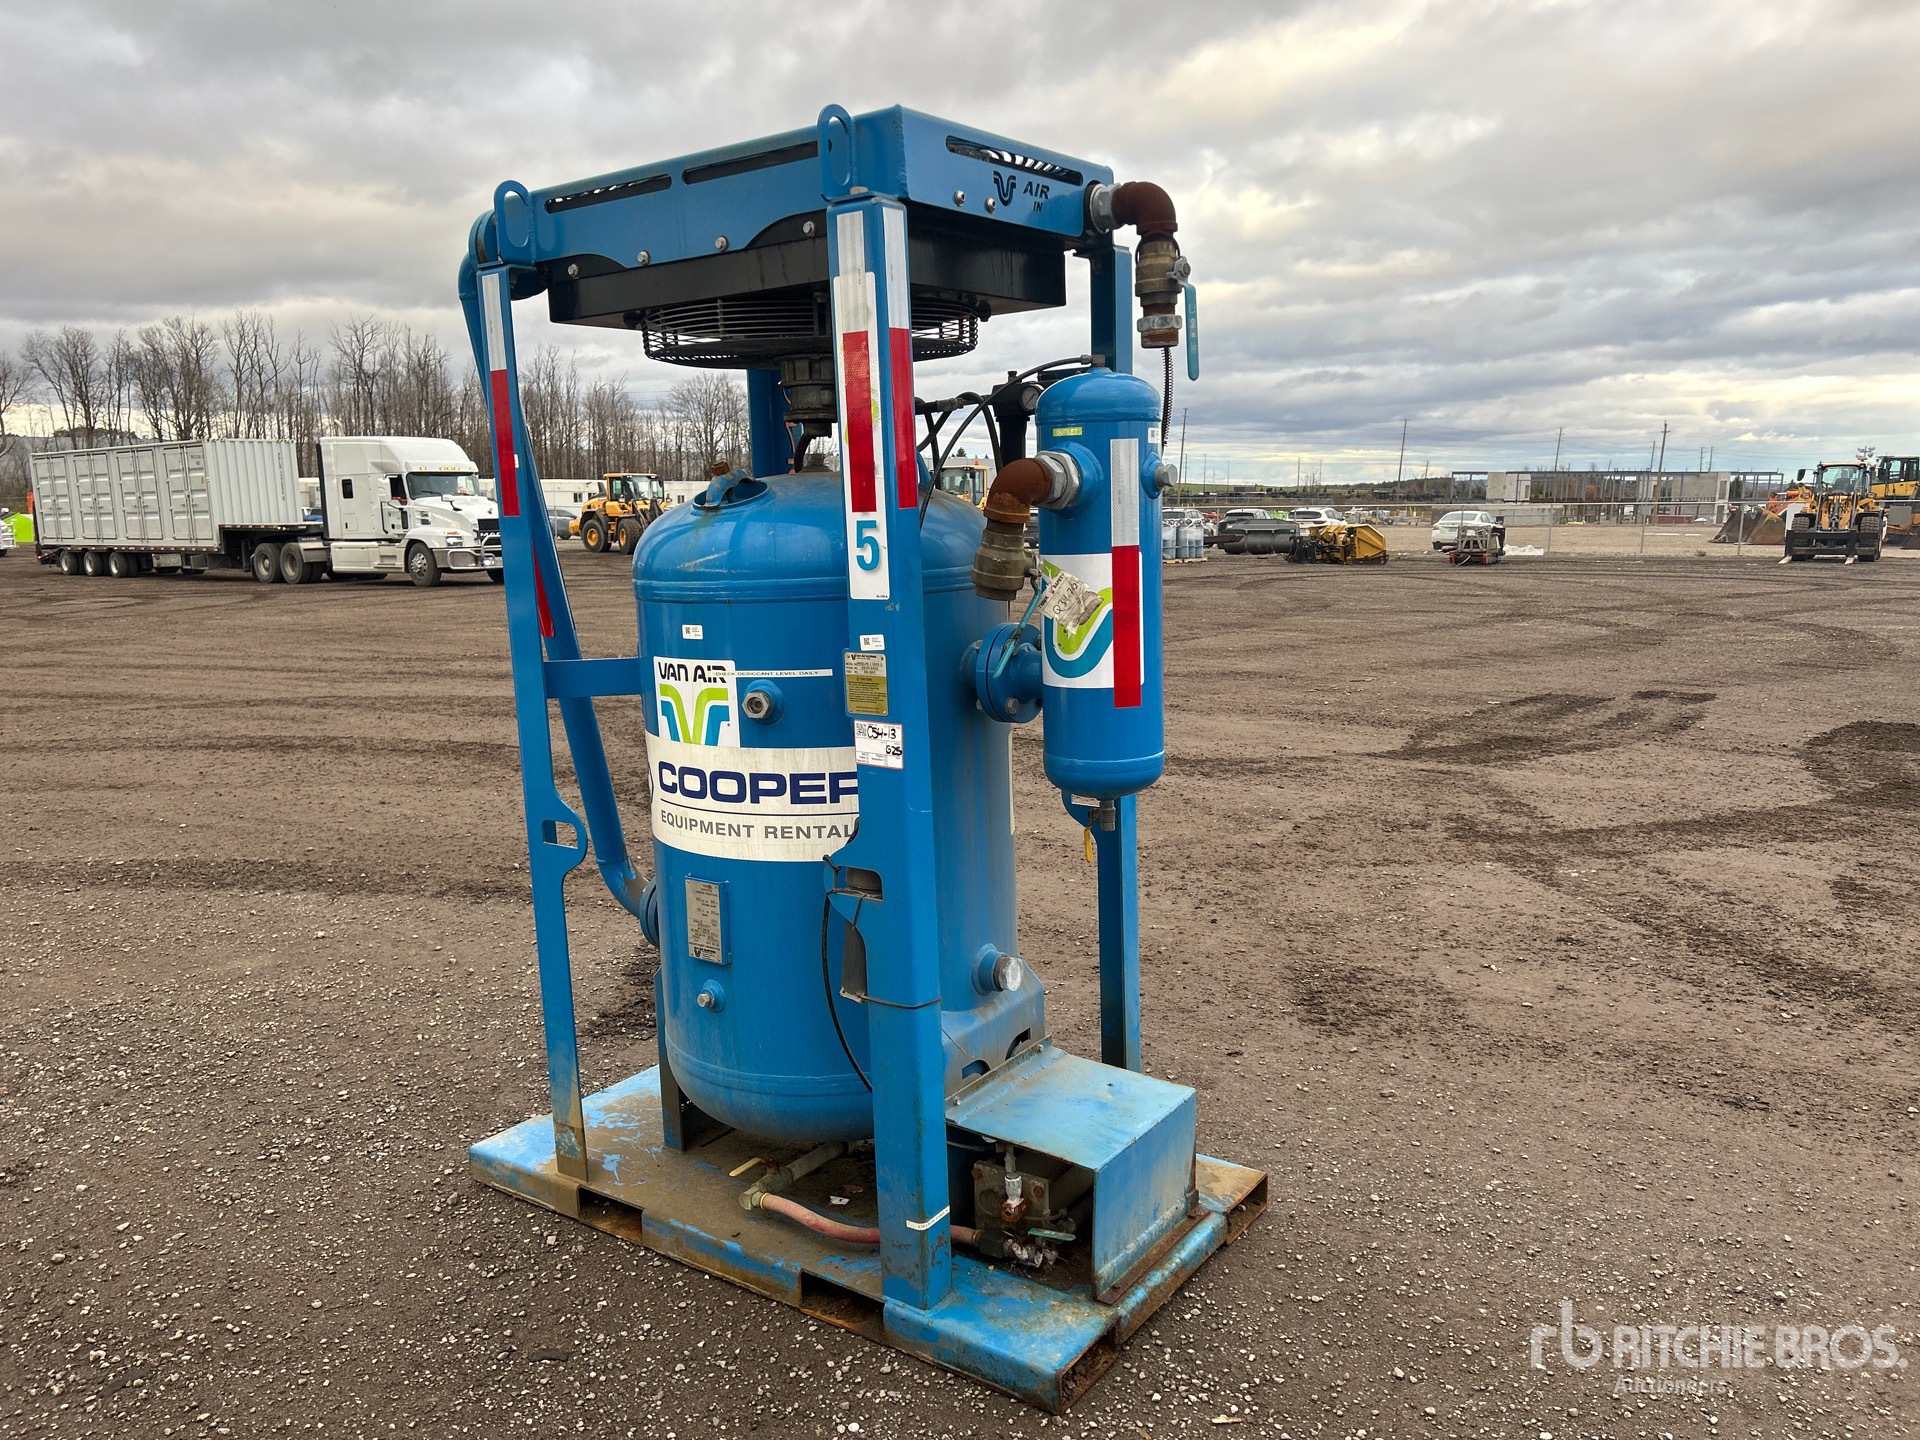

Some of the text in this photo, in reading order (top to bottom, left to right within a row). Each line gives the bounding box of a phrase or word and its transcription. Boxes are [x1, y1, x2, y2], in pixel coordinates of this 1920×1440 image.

[1023, 181, 1050, 200] AIR
[1033, 201, 1043, 213] IN
[856, 519, 880, 572] 5
[657, 661, 727, 684] VAN AIR
[661, 810, 854, 839] EQUIPMENT RENTAL
